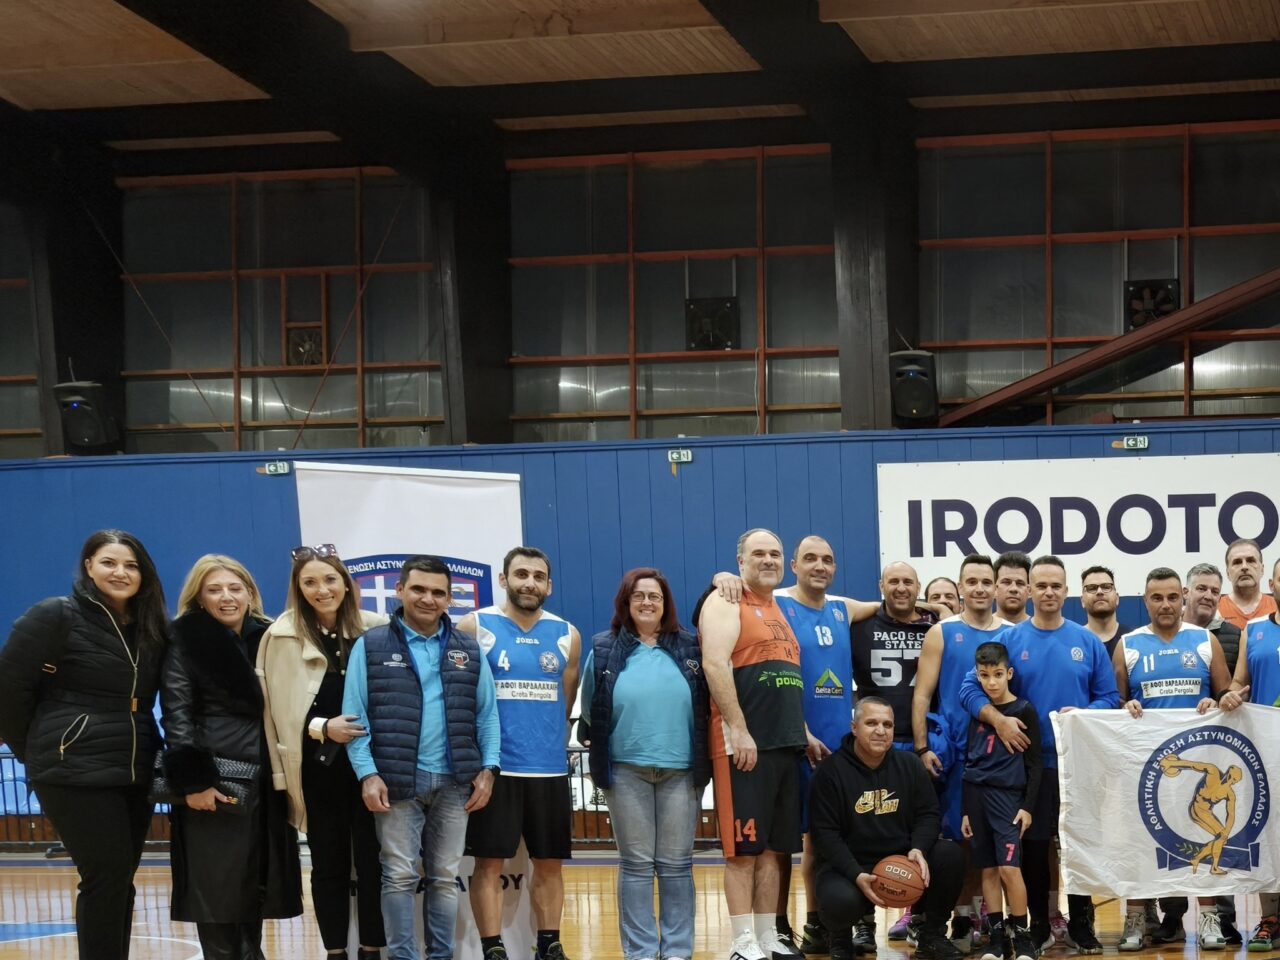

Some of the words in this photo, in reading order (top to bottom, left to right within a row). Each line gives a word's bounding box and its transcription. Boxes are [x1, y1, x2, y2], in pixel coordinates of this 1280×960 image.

[349, 562, 375, 573] ΕΝΩΣΗ
[447, 563, 484, 577] ΑΛΛΗΛΩΝ
[814, 625, 834, 646] 13
[873, 631, 906, 641] PACO
[885, 640, 922, 649] STATE
[498, 649, 511, 671] 4
[1143, 653, 1155, 673] 11
[1152, 738, 1185, 770] ΕΝΩΣΗ
[1188, 731, 1260, 771] ΑΣΤΥΝΟΜΙΚΩΝ
[1145, 771, 1163, 831] ΑΘΛΗΤΙΚΗ
[1251, 773, 1266, 827] ΕΛΛΑΔΟΣ
[735, 818, 757, 842] 14
